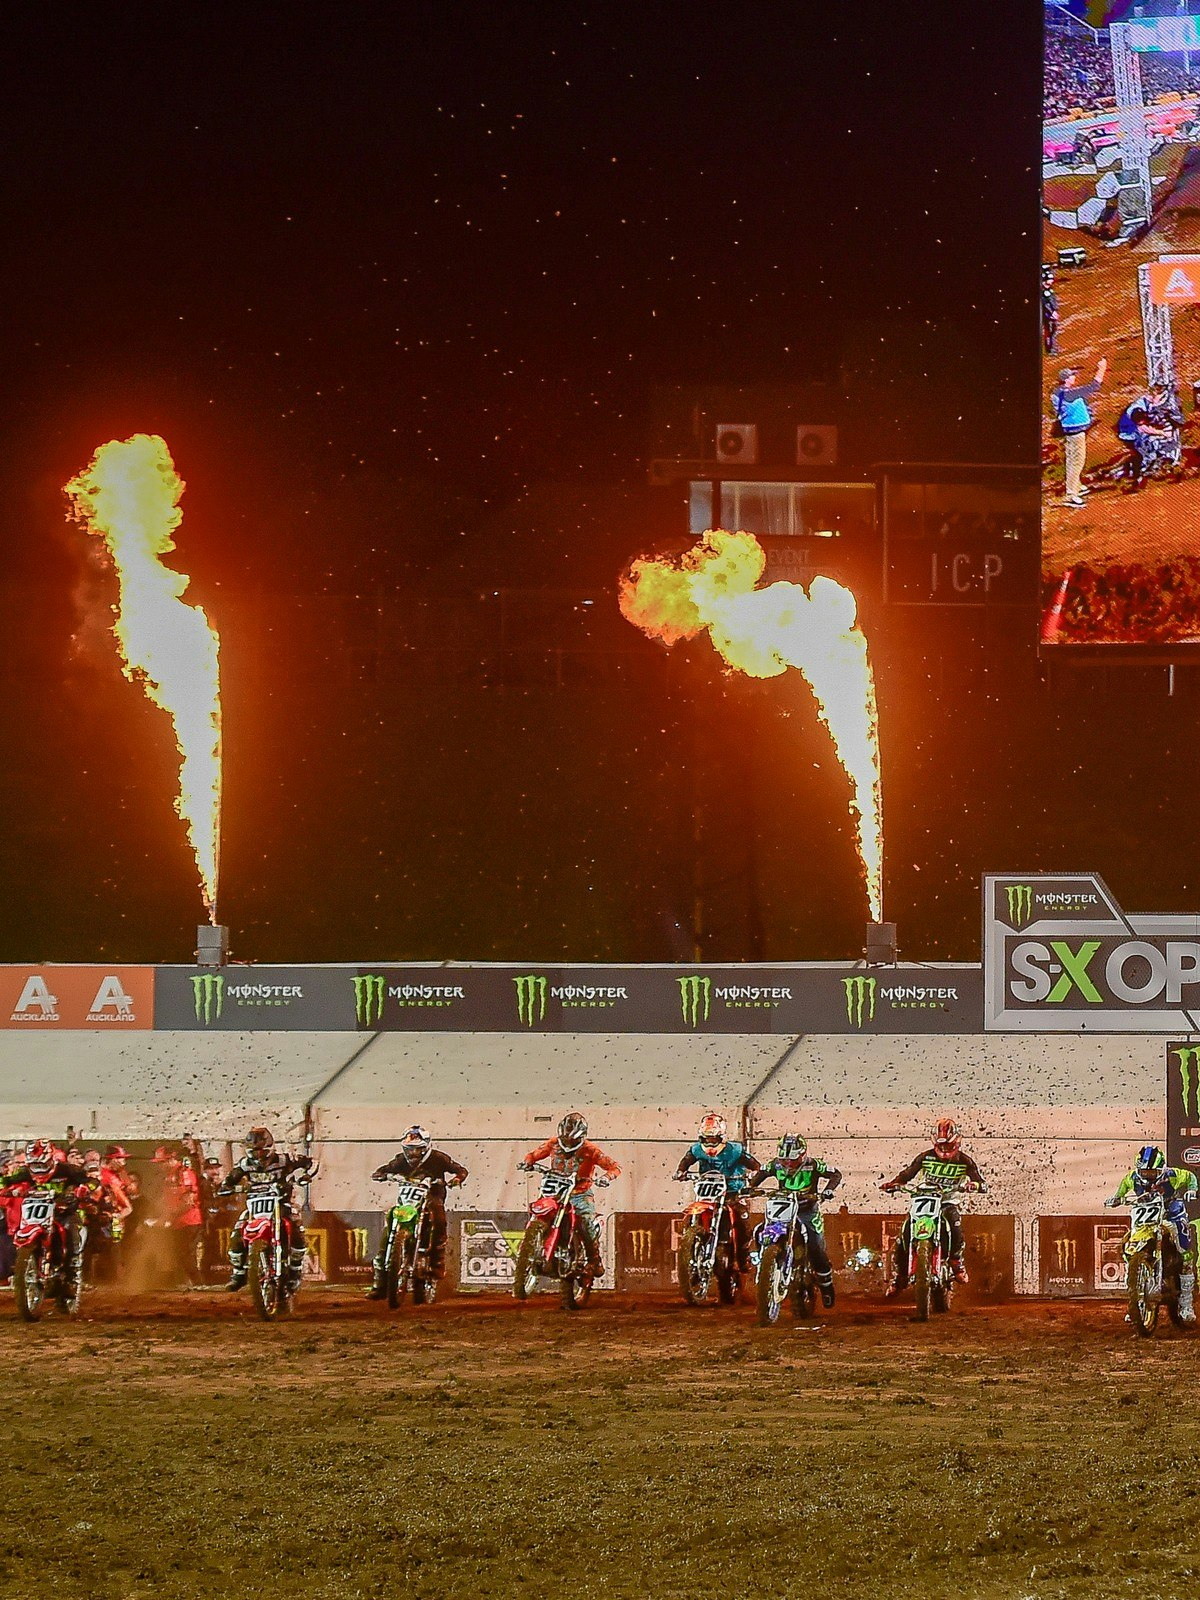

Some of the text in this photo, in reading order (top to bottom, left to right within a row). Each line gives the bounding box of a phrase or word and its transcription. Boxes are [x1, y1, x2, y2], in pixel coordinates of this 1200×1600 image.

[1035, 891, 1098, 905] MONSTER
[227, 984, 303, 999] MONSTER
[389, 985, 465, 999] MONSTER
[551, 985, 628, 1000] MONSTER
[715, 985, 792, 1000] MONSTER
[881, 985, 958, 1000] MONSTER
[10, 1013, 60, 1021] AUCKLAND
[86, 1013, 136, 1021] AUCKLAND
[400, 1187, 424, 1200] 46
[542, 1179, 572, 1198] 57
[697, 1182, 724, 1197] 106
[26, 1205, 49, 1219] 10
[250, 1200, 274, 1214] 100
[772, 1202, 790, 1218] 7
[914, 1198, 936, 1213] 71
[1136, 1208, 1159, 1224] 22
